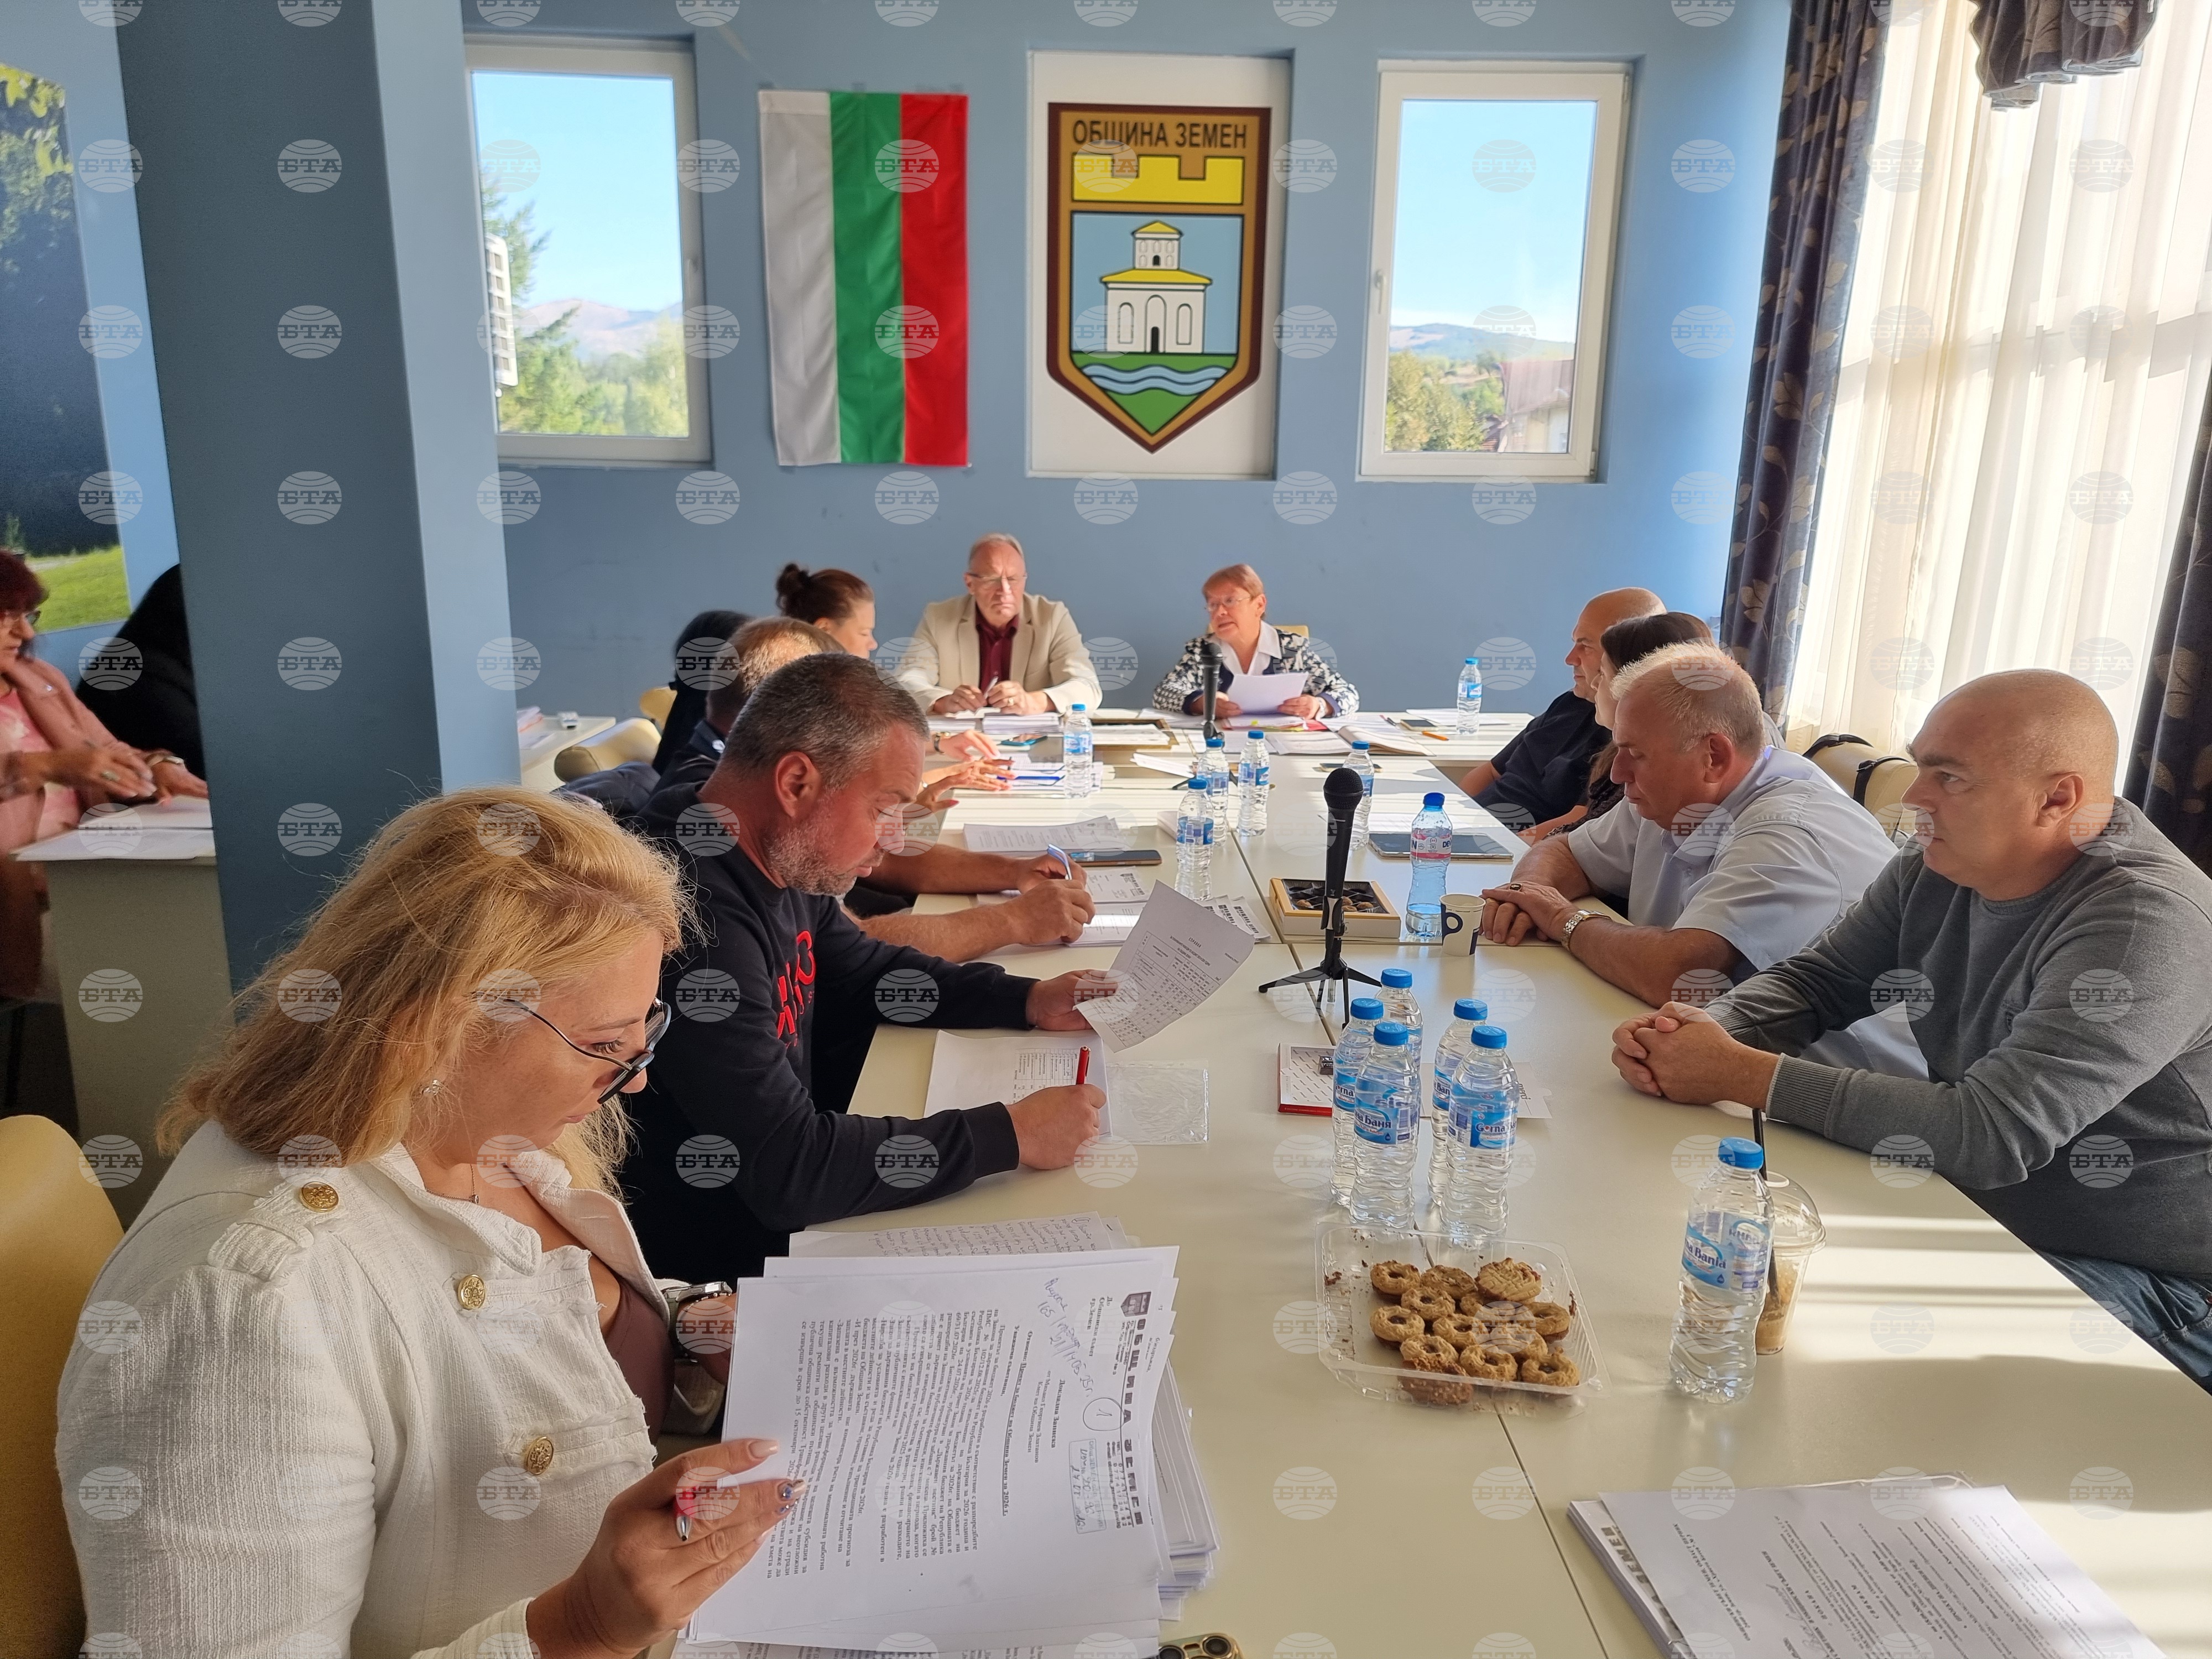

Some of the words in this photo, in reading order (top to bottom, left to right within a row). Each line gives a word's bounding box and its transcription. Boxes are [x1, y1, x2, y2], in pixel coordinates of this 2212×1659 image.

[1072, 119, 1168, 150] ОБЩИНА
[1175, 122, 1247, 148] ЗЕМЕН
[1437, 1084, 1451, 1095] Ban
[1365, 1114, 1391, 1129] Баня
[1475, 1123, 1505, 1133] Gorna
[1695, 1246, 1726, 1270] Bania
[1124, 1318, 1146, 1424] ОБЩИНА
[1054, 1379, 1066, 1415] Докладна
[1029, 1406, 1038, 1432] Община
[1036, 1404, 1046, 1432] Георгиев
[1051, 1416, 1060, 1448] Записка
[1004, 1429, 1013, 1458] Община
[1124, 1438, 1144, 1525] ЗЕМЕН
[937, 1515, 946, 1554] Република
[970, 1501, 979, 1550] разпоредбите
[802, 1528, 811, 1561] субсидия
